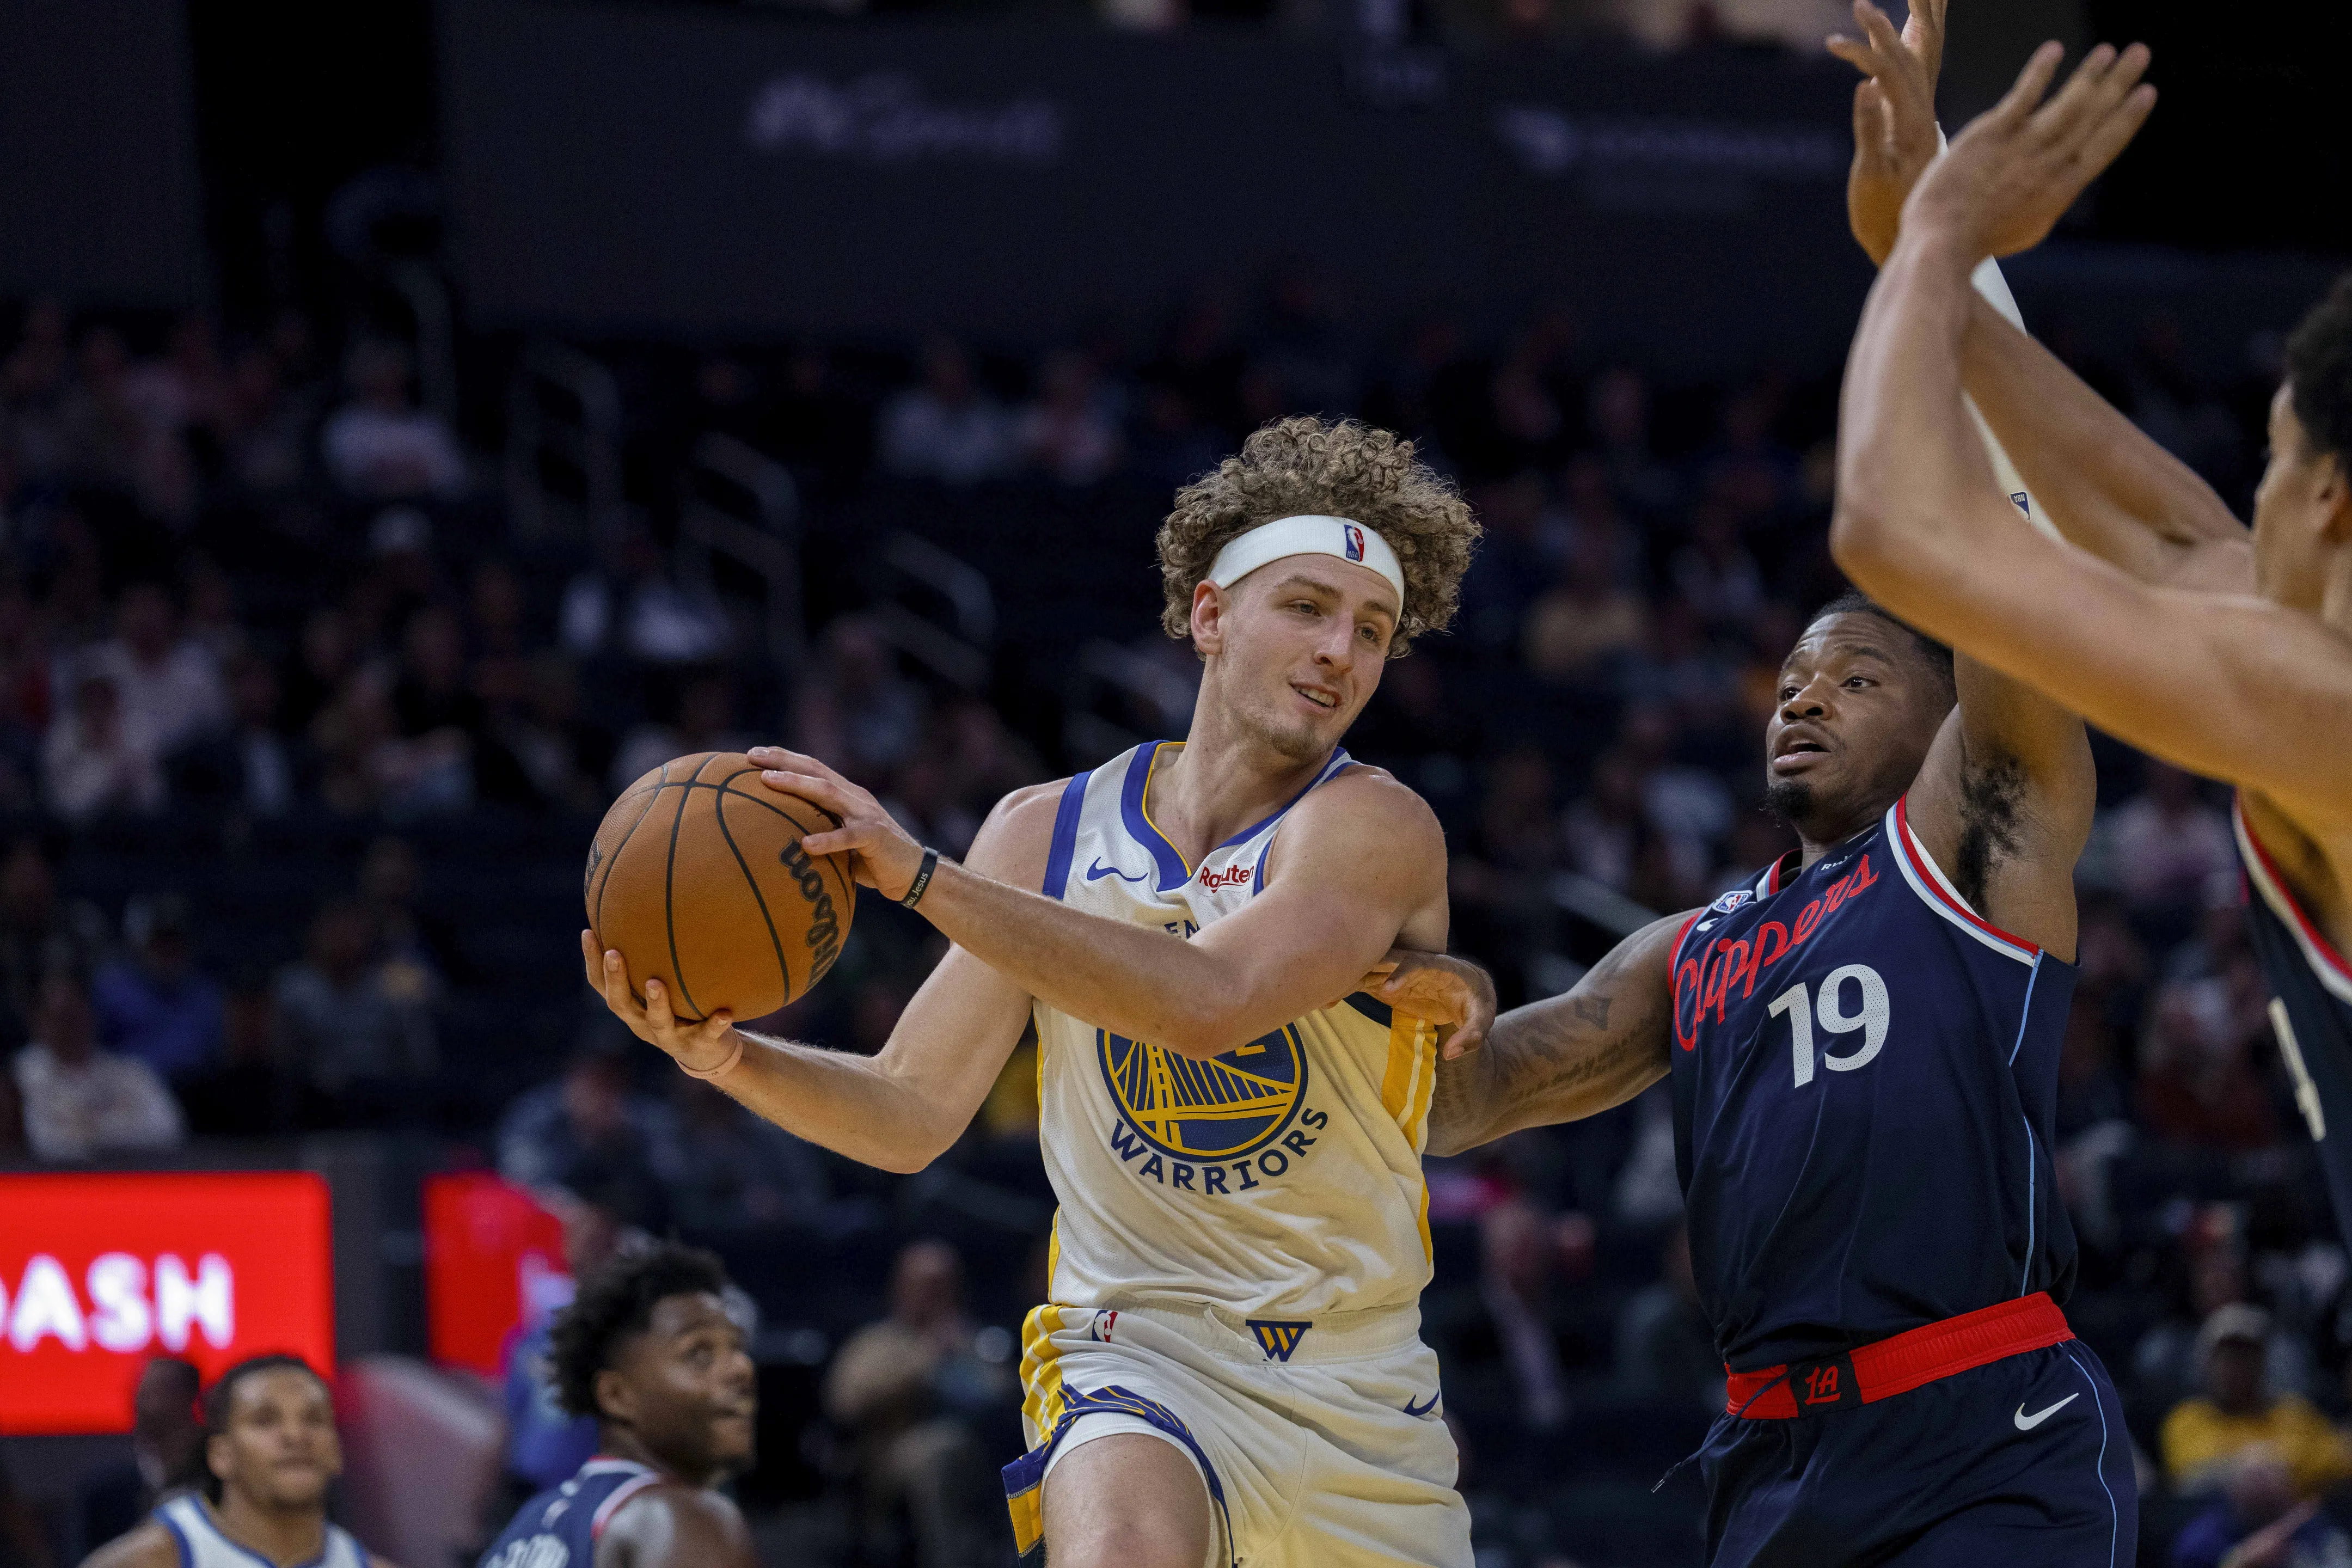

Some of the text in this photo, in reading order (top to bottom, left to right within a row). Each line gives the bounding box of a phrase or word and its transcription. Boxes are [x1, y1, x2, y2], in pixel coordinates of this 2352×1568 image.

[2014, 494, 2025, 503] NBA
[1347, 550, 1358, 559] NBA
[912, 872, 928, 896] Jesus
[1199, 864, 1254, 889] Rauten
[1674, 854, 1879, 1051] Clippers
[1768, 964, 1890, 1088] 19
[1110, 1107, 1328, 1195] WARRIORS
[0, 1253, 235, 1353] ASH
[1804, 1365, 1841, 1405] LA
